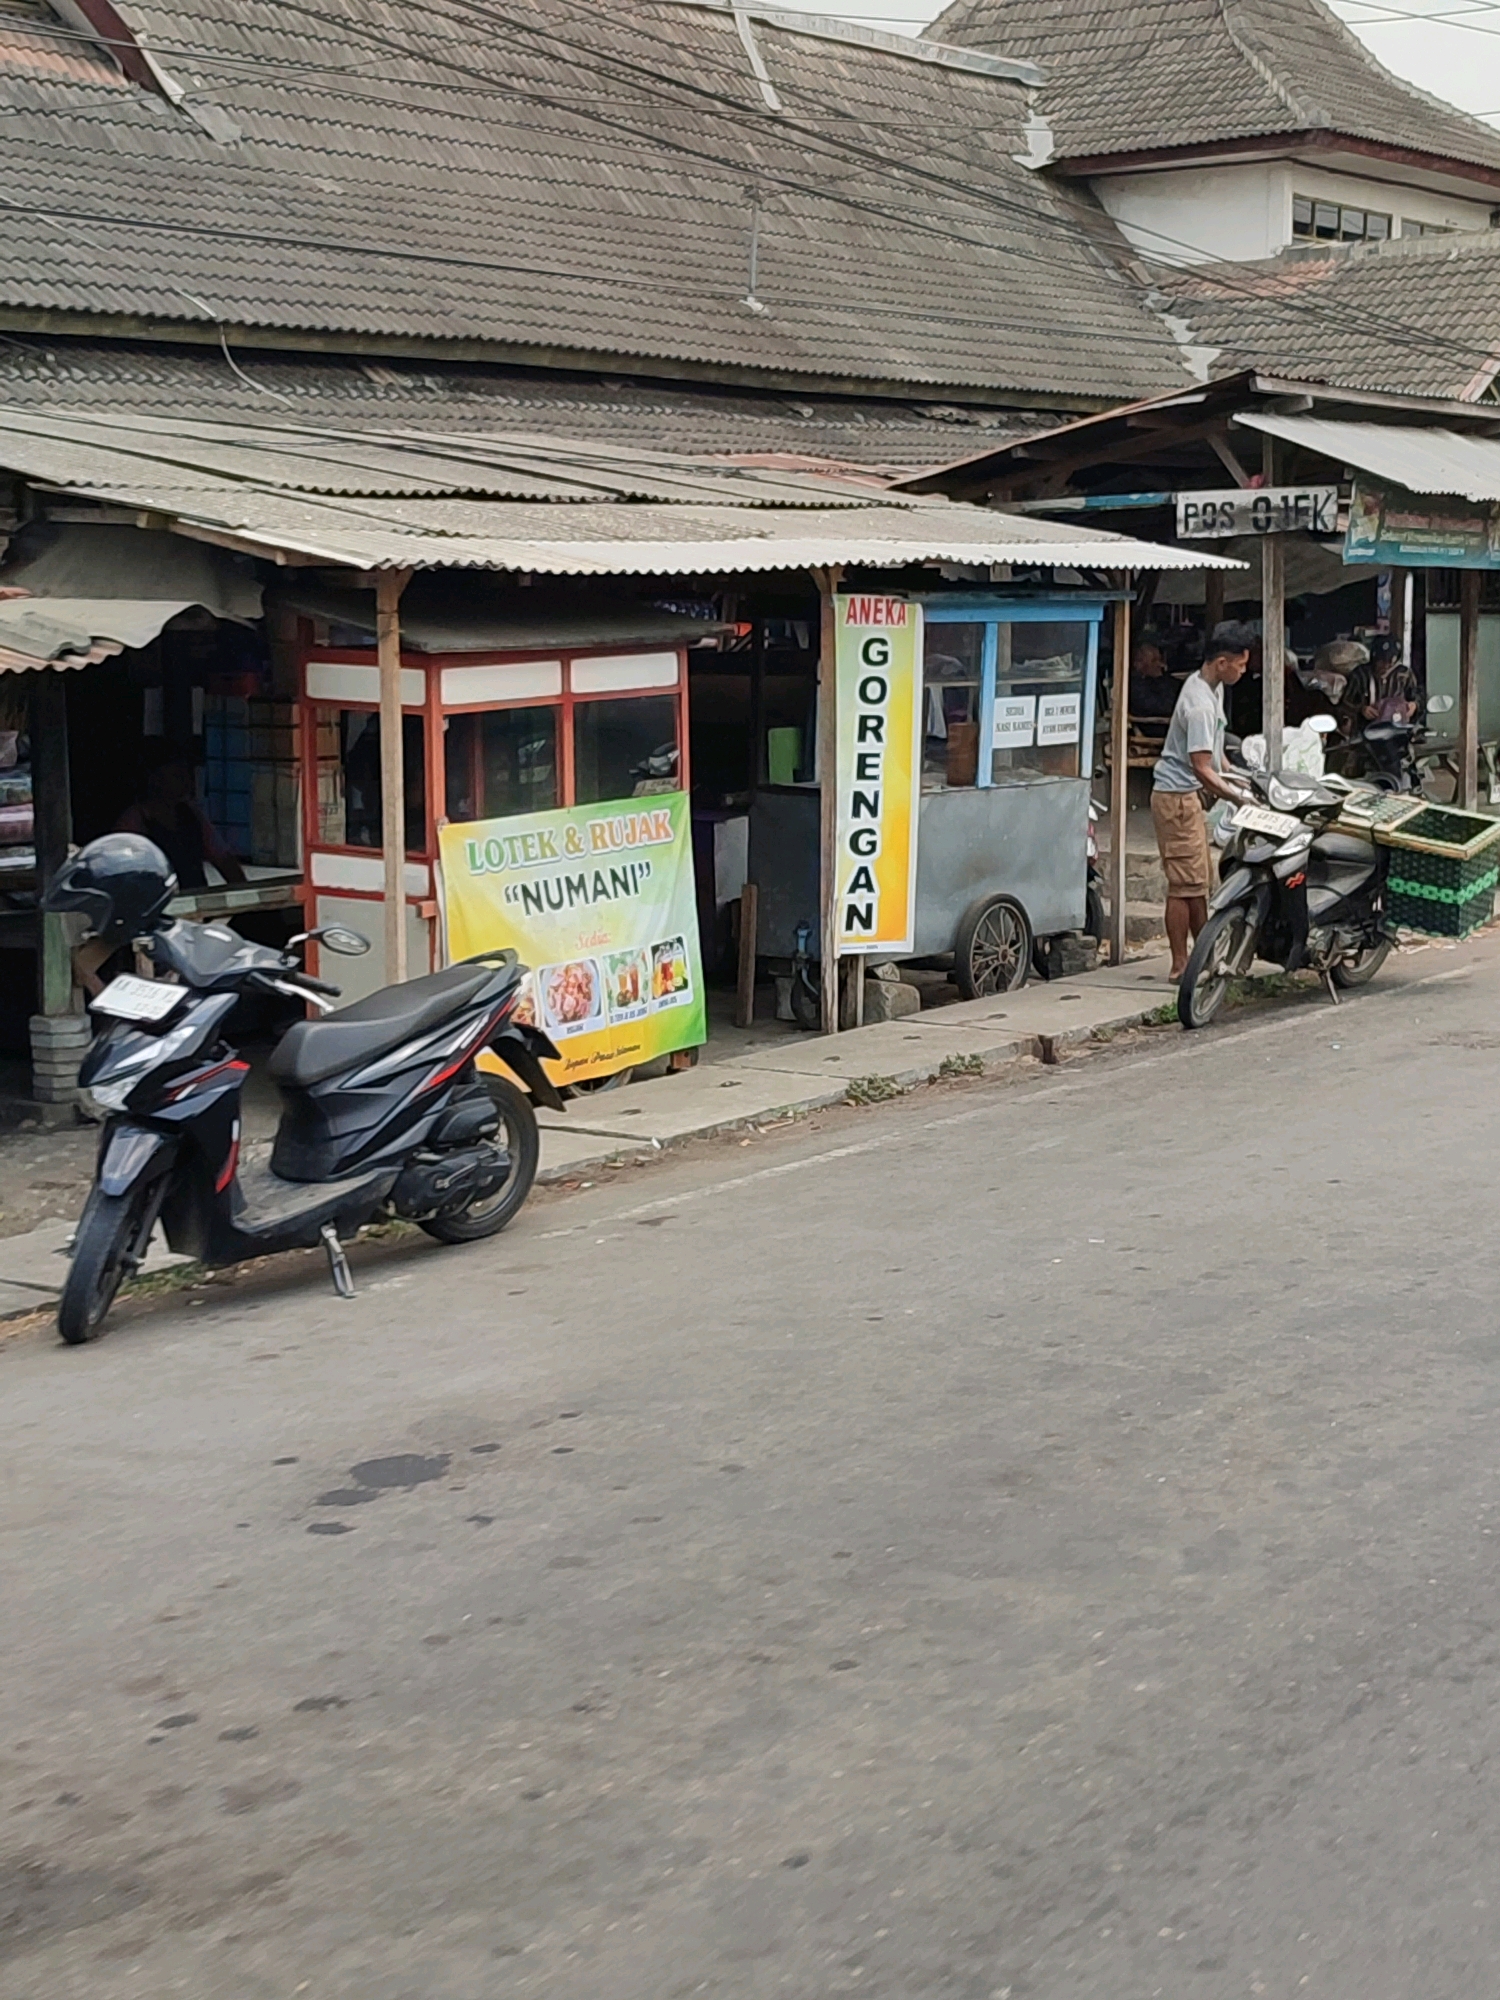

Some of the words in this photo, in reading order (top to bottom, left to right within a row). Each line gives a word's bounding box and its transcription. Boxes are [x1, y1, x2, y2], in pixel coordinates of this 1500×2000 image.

[1184, 502, 1235, 533] POS
[846, 597, 906, 625] ANEKA
[845, 637, 888, 932] GORENGAN
[467, 830, 560, 871] LOTEK
[564, 826, 584, 854] &
[590, 812, 672, 851] RUJAK
